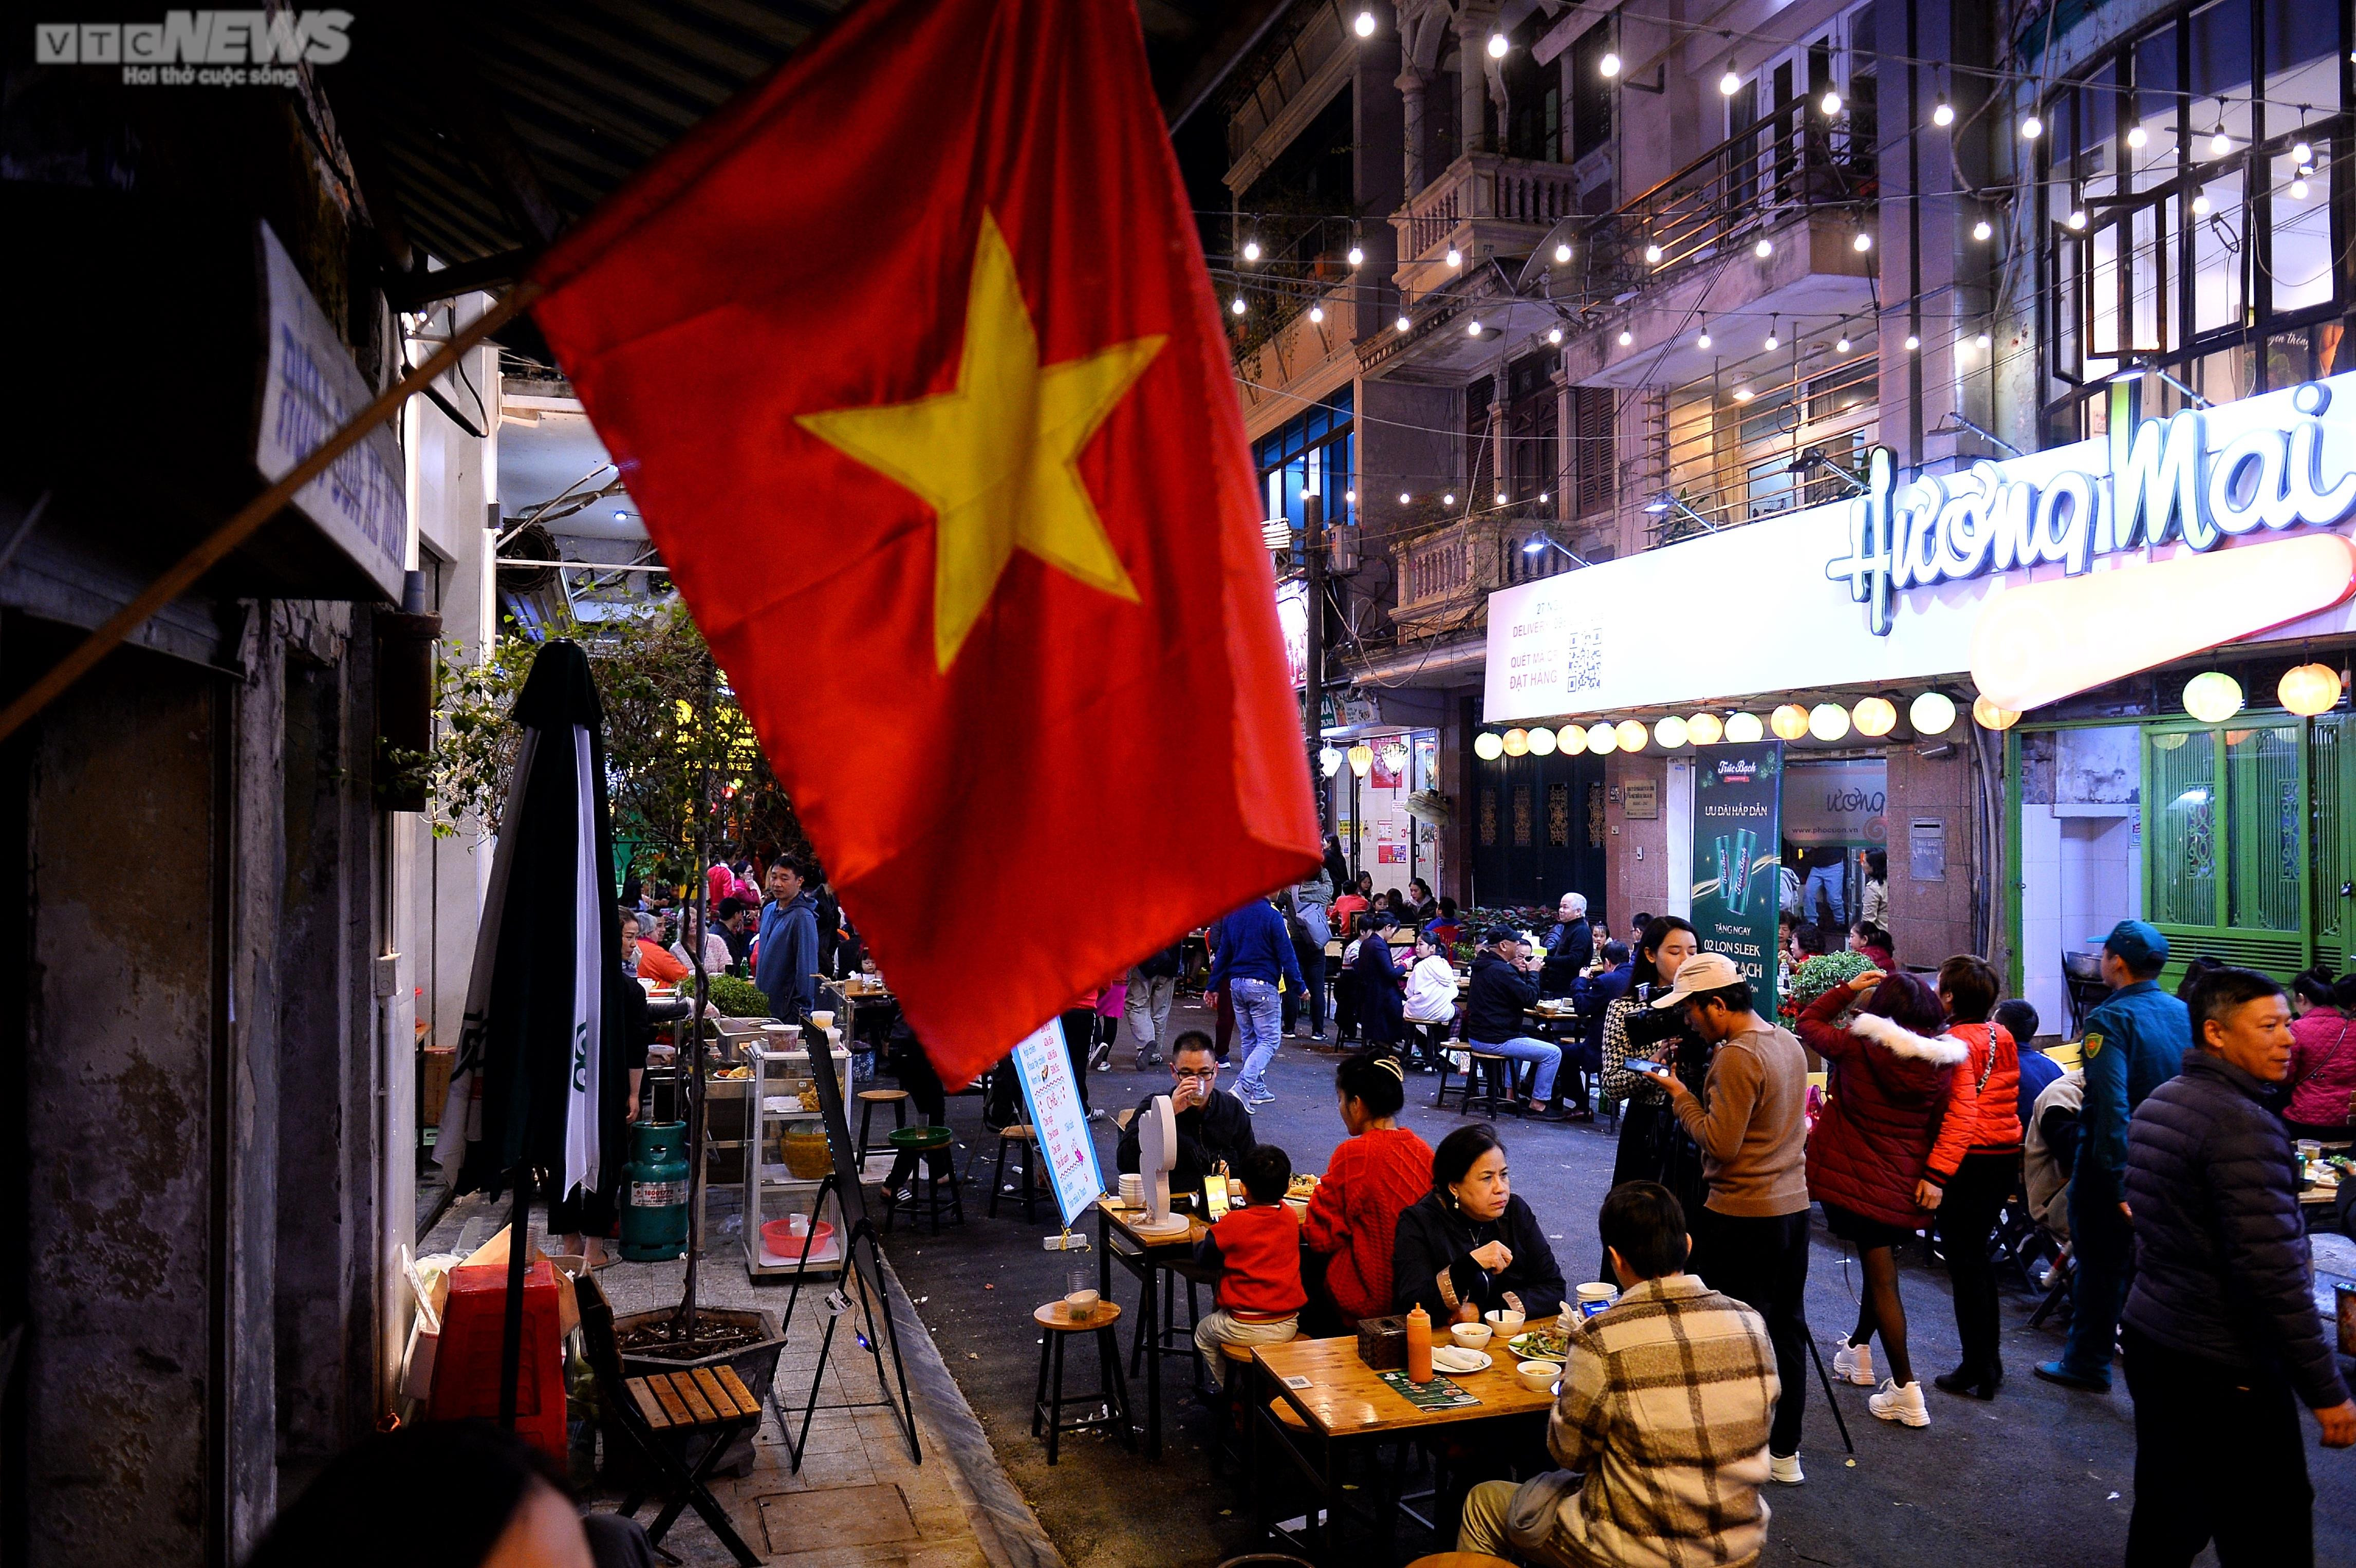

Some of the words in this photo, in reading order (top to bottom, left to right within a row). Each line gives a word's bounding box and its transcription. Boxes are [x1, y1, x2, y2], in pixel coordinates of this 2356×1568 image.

[2109, 381, 2356, 553] Mai
[1511, 652, 1531, 667] QUÉT
[1510, 674, 1528, 692] ĐẠT
[1733, 926, 1751, 936] NGAY
[1704, 939, 1714, 950] 02
[1715, 941, 1733, 953] LON
[1734, 943, 1761, 957] SLEEK
